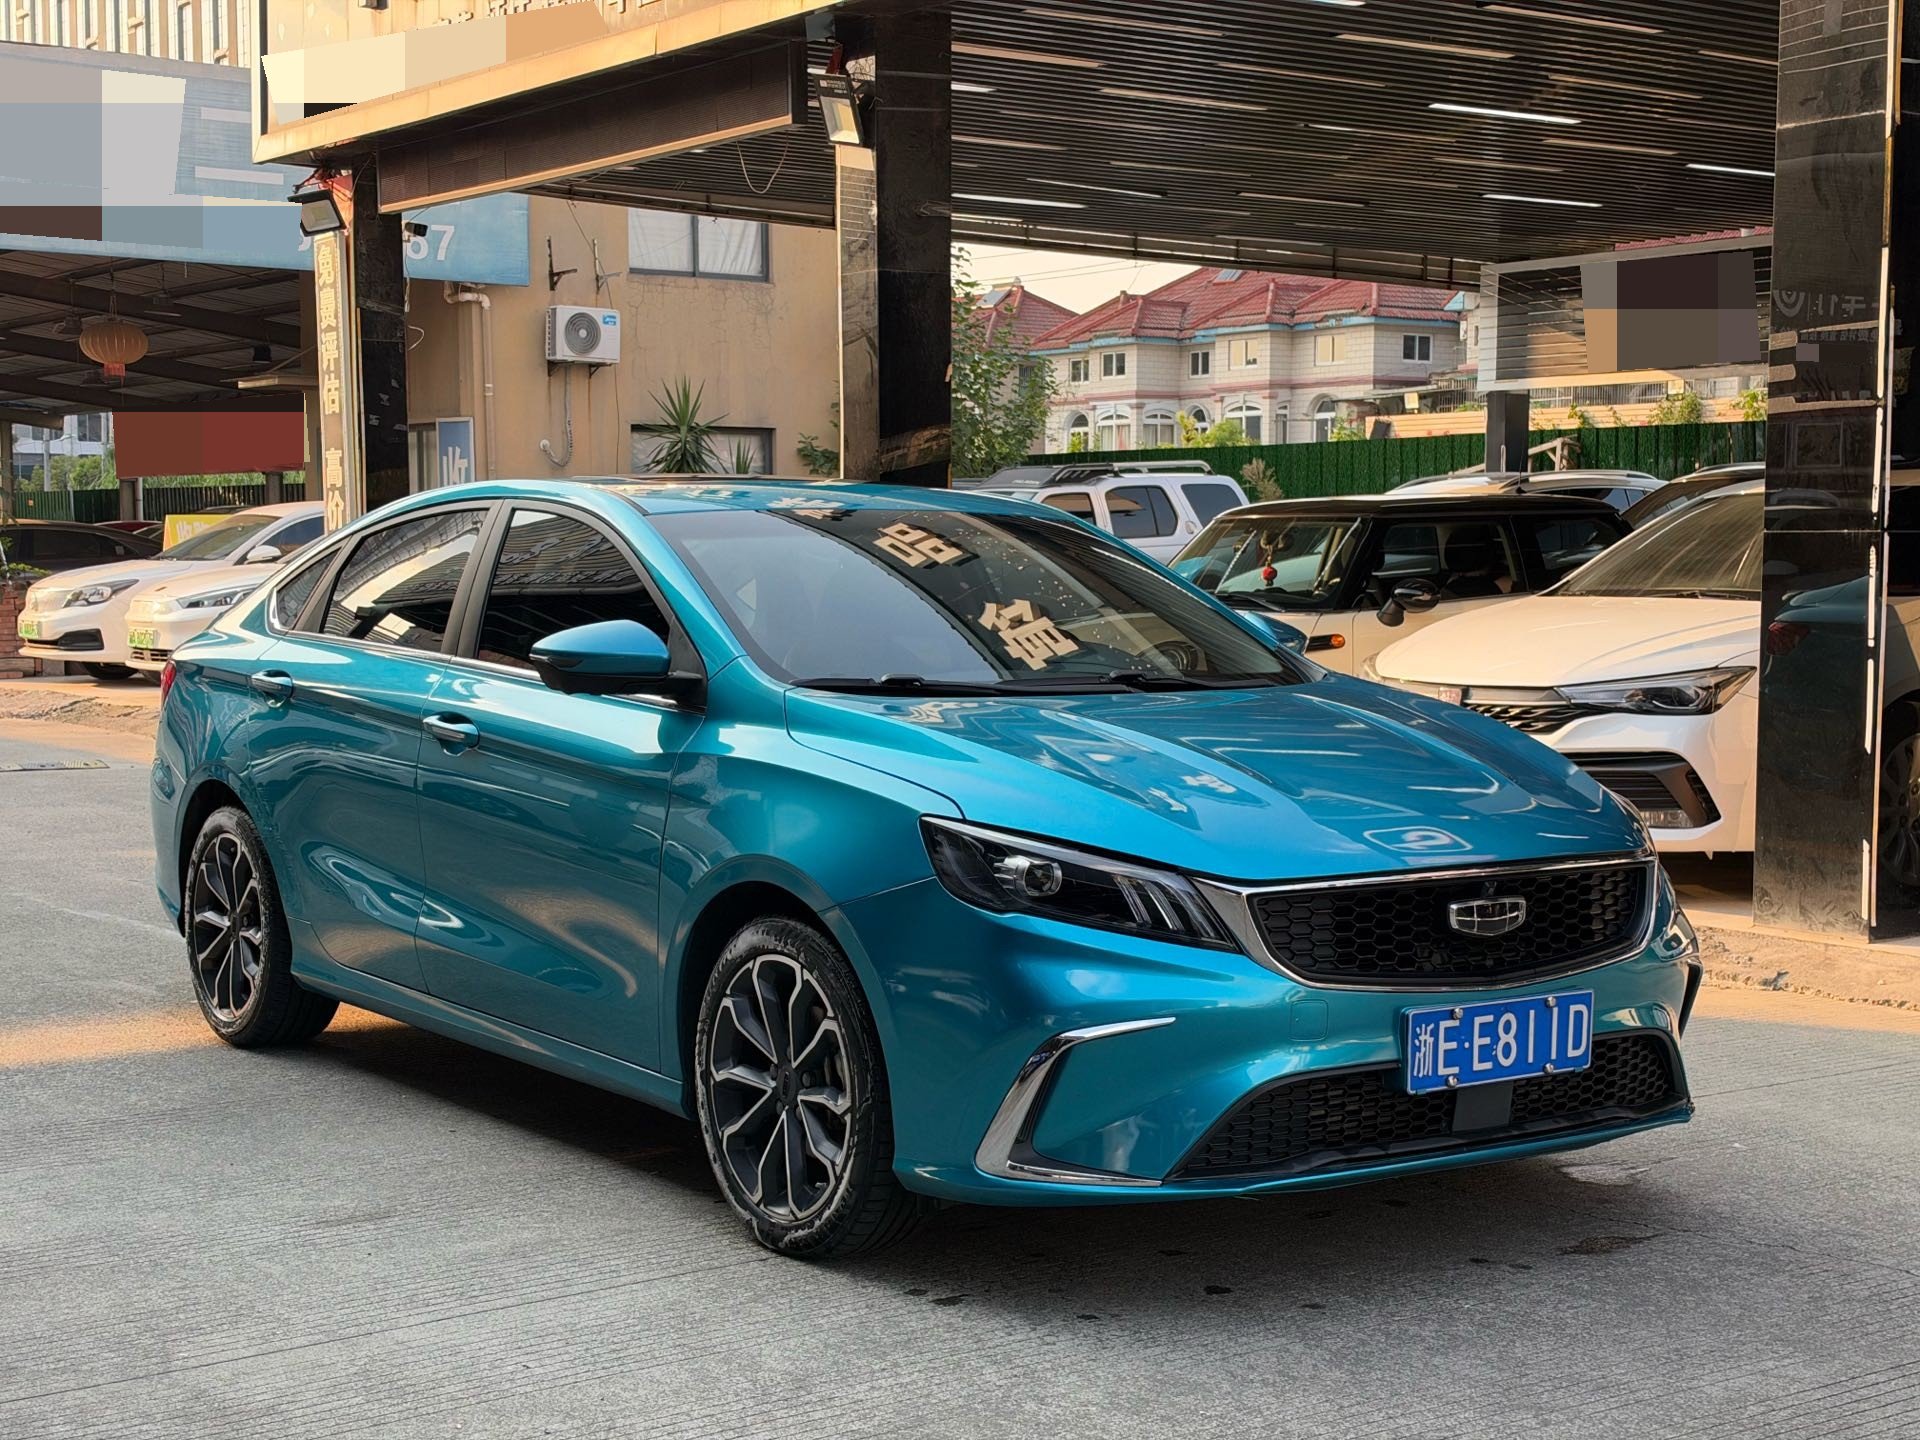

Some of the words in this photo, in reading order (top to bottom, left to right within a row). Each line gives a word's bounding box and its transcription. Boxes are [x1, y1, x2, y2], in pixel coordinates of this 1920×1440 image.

[318, 246, 340, 415] 免费评估
[325, 447, 344, 531] 高价
